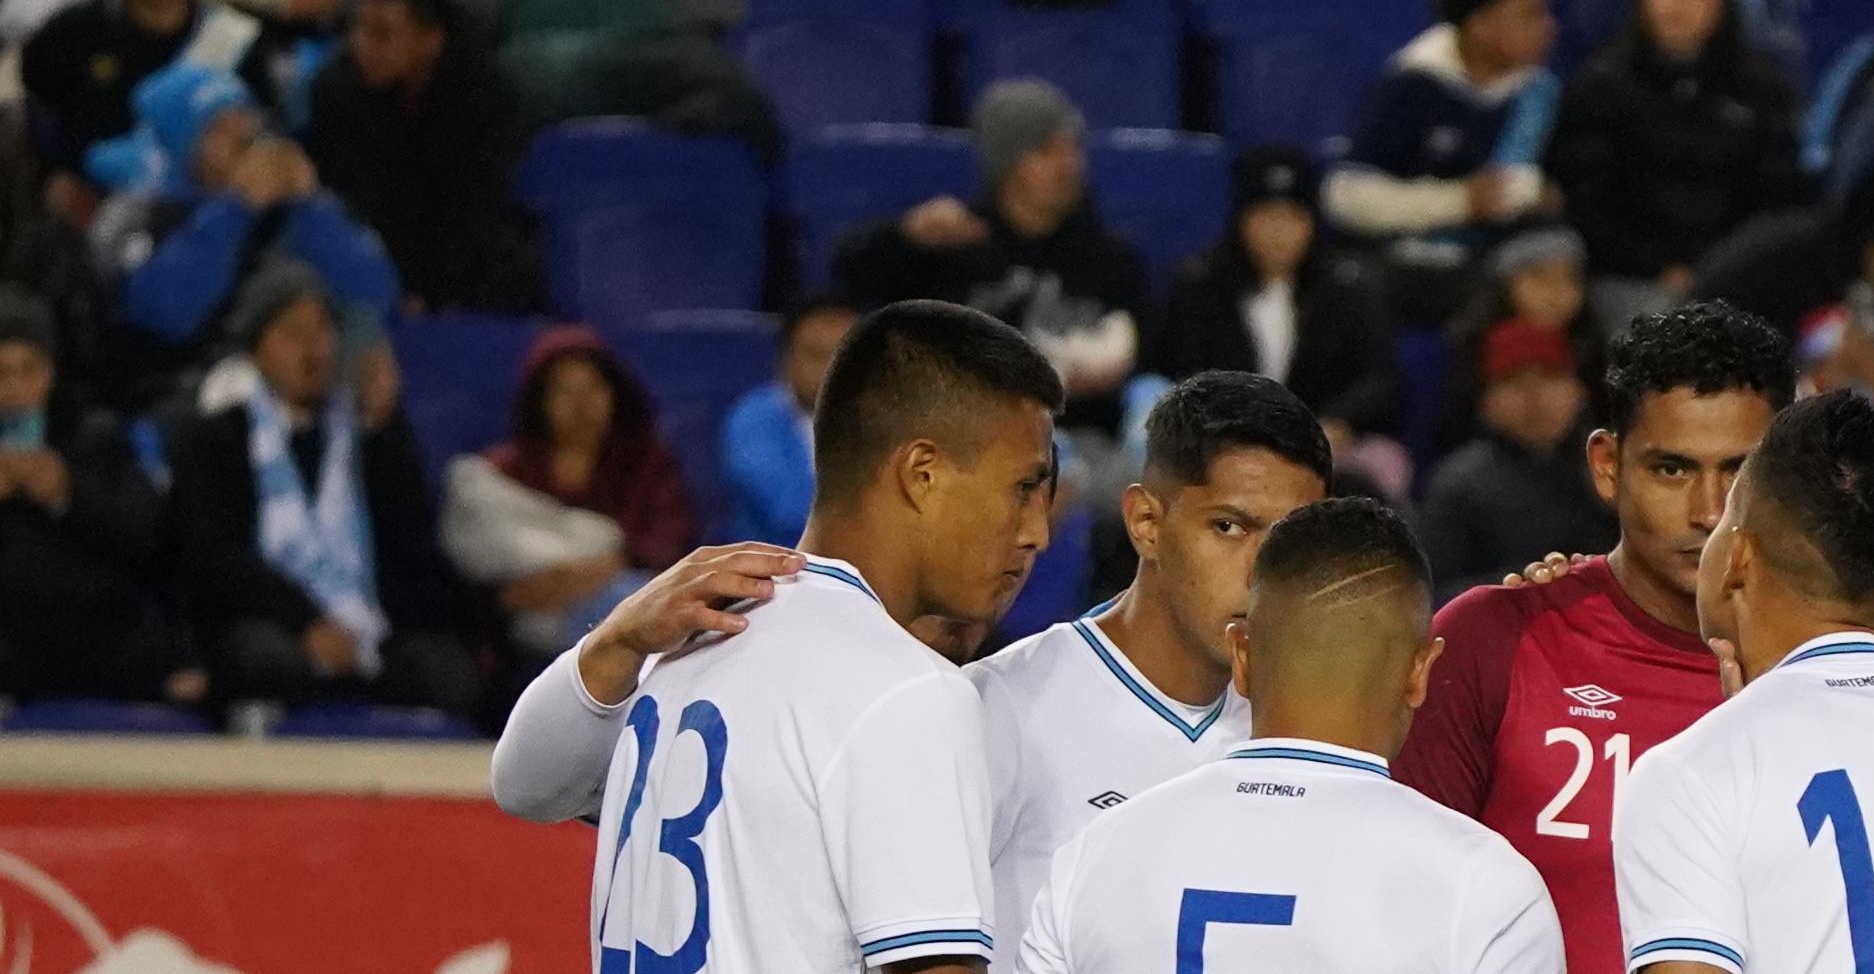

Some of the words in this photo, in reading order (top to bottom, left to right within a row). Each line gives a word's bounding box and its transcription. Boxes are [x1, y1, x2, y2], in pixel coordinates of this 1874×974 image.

[1569, 705, 1617, 721] umbro
[1236, 782, 1306, 798] GUATEMALA
[1535, 726, 1631, 840] 21
